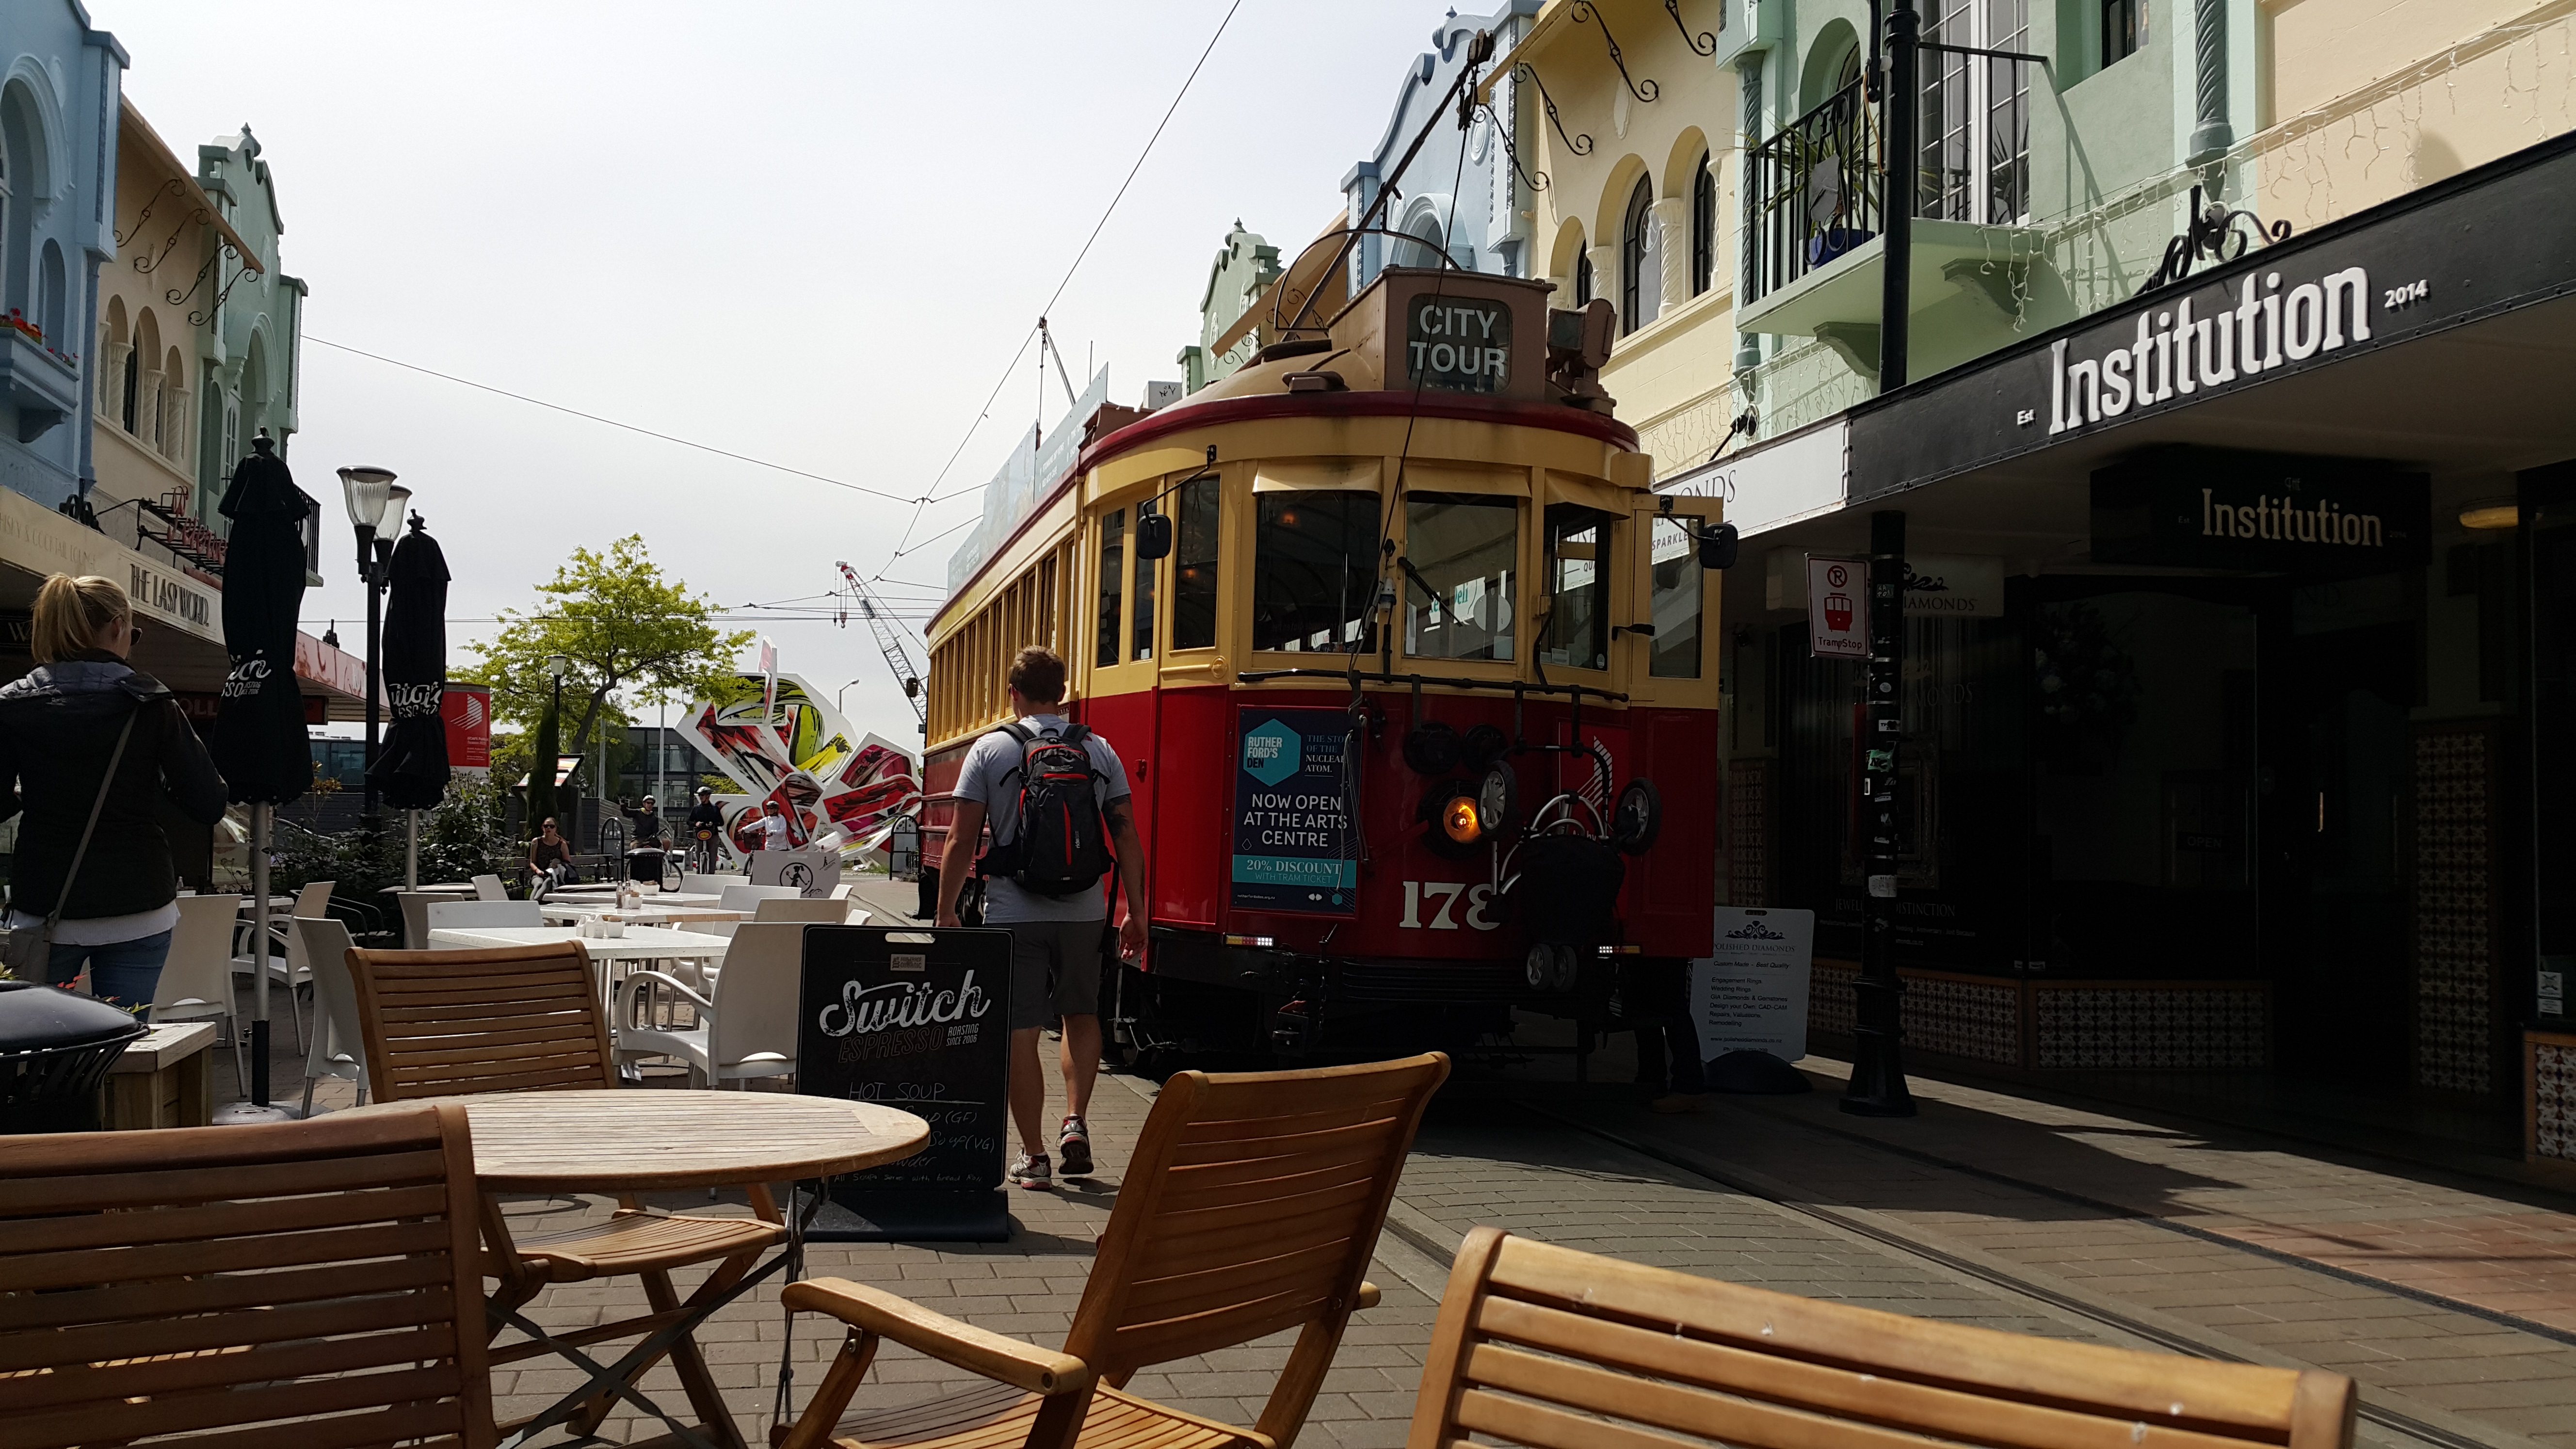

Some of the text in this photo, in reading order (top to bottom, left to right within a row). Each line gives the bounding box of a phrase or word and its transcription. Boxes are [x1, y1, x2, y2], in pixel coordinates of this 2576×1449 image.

[1419, 304, 1498, 339] CITY
[2049, 266, 2371, 435] Institution
[2385, 280, 2428, 308] 2014
[1410, 340, 1506, 377] TOUR
[2202, 488, 2383, 547] Institution
[1904, 596, 1978, 611] IAMONDS
[1818, 636, 1862, 650] Tram Stop
[1248, 736, 1283, 747] RUTHER
[1307, 735, 1325, 743] THE
[1247, 747, 1278, 758] FORD'S
[1247, 757, 1264, 769] DEN
[1304, 764, 1332, 773] ATOM.
[1252, 794, 1341, 811] NOW OPEN
[1243, 811, 1348, 830] AT THE ARTS
[1262, 830, 1328, 847] CENTRE
[1246, 859, 1342, 874] 20% DISCOUNT
[1255, 872, 1332, 884] WITH TRAM TICKET
[819, 969, 991, 1037] Switch
[948, 1023, 979, 1037] ROASTING
[838, 1025, 944, 1063] ESPRESSO
[946, 1034, 978, 1046] SINCE 2006
[849, 1081, 945, 1101] HOT SOUP
[945, 1110, 977, 1124] (GF)
